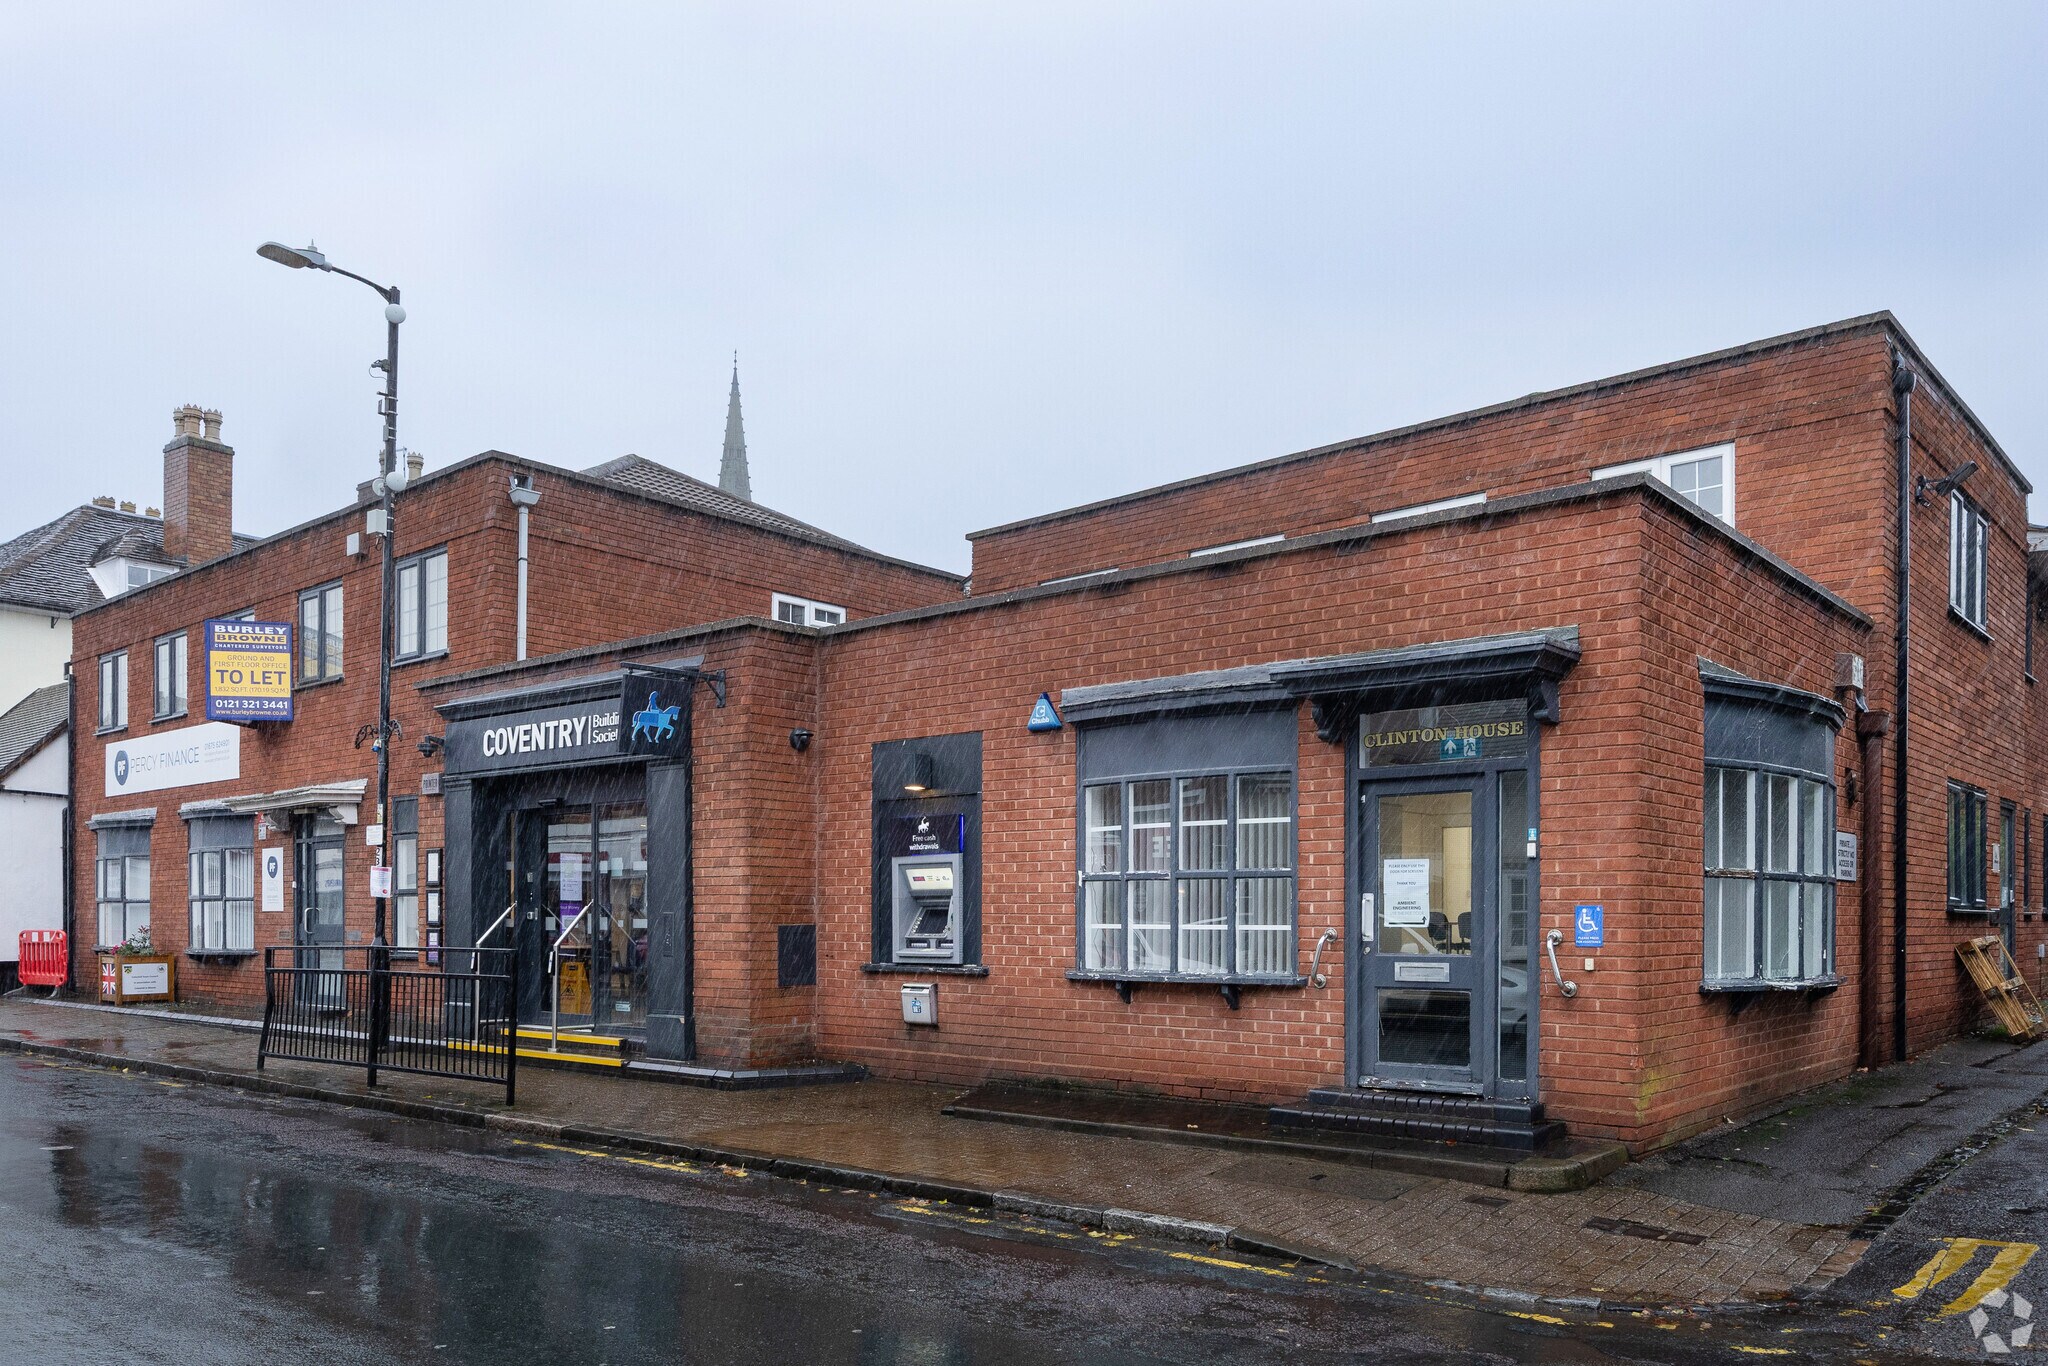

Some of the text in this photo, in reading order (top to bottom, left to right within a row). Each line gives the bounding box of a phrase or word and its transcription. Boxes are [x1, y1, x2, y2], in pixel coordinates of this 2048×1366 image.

[214, 625, 287, 634] BURLEY
[216, 634, 286, 643] BROWNE
[216, 669, 287, 686] TO LET
[215, 699, 288, 709] 0121 321 3441
[593, 712, 620, 728] Buildi
[1031, 716, 1049, 724] Chubb
[483, 716, 587, 757] COVENTRY
[593, 728, 619, 744] Societ
[1364, 721, 1524, 748] CLINTON HOUSE
[117, 760, 126, 776] PF
[130, 747, 200, 774] PERCY FINANCE
[909, 842, 939, 850] withdrawals
